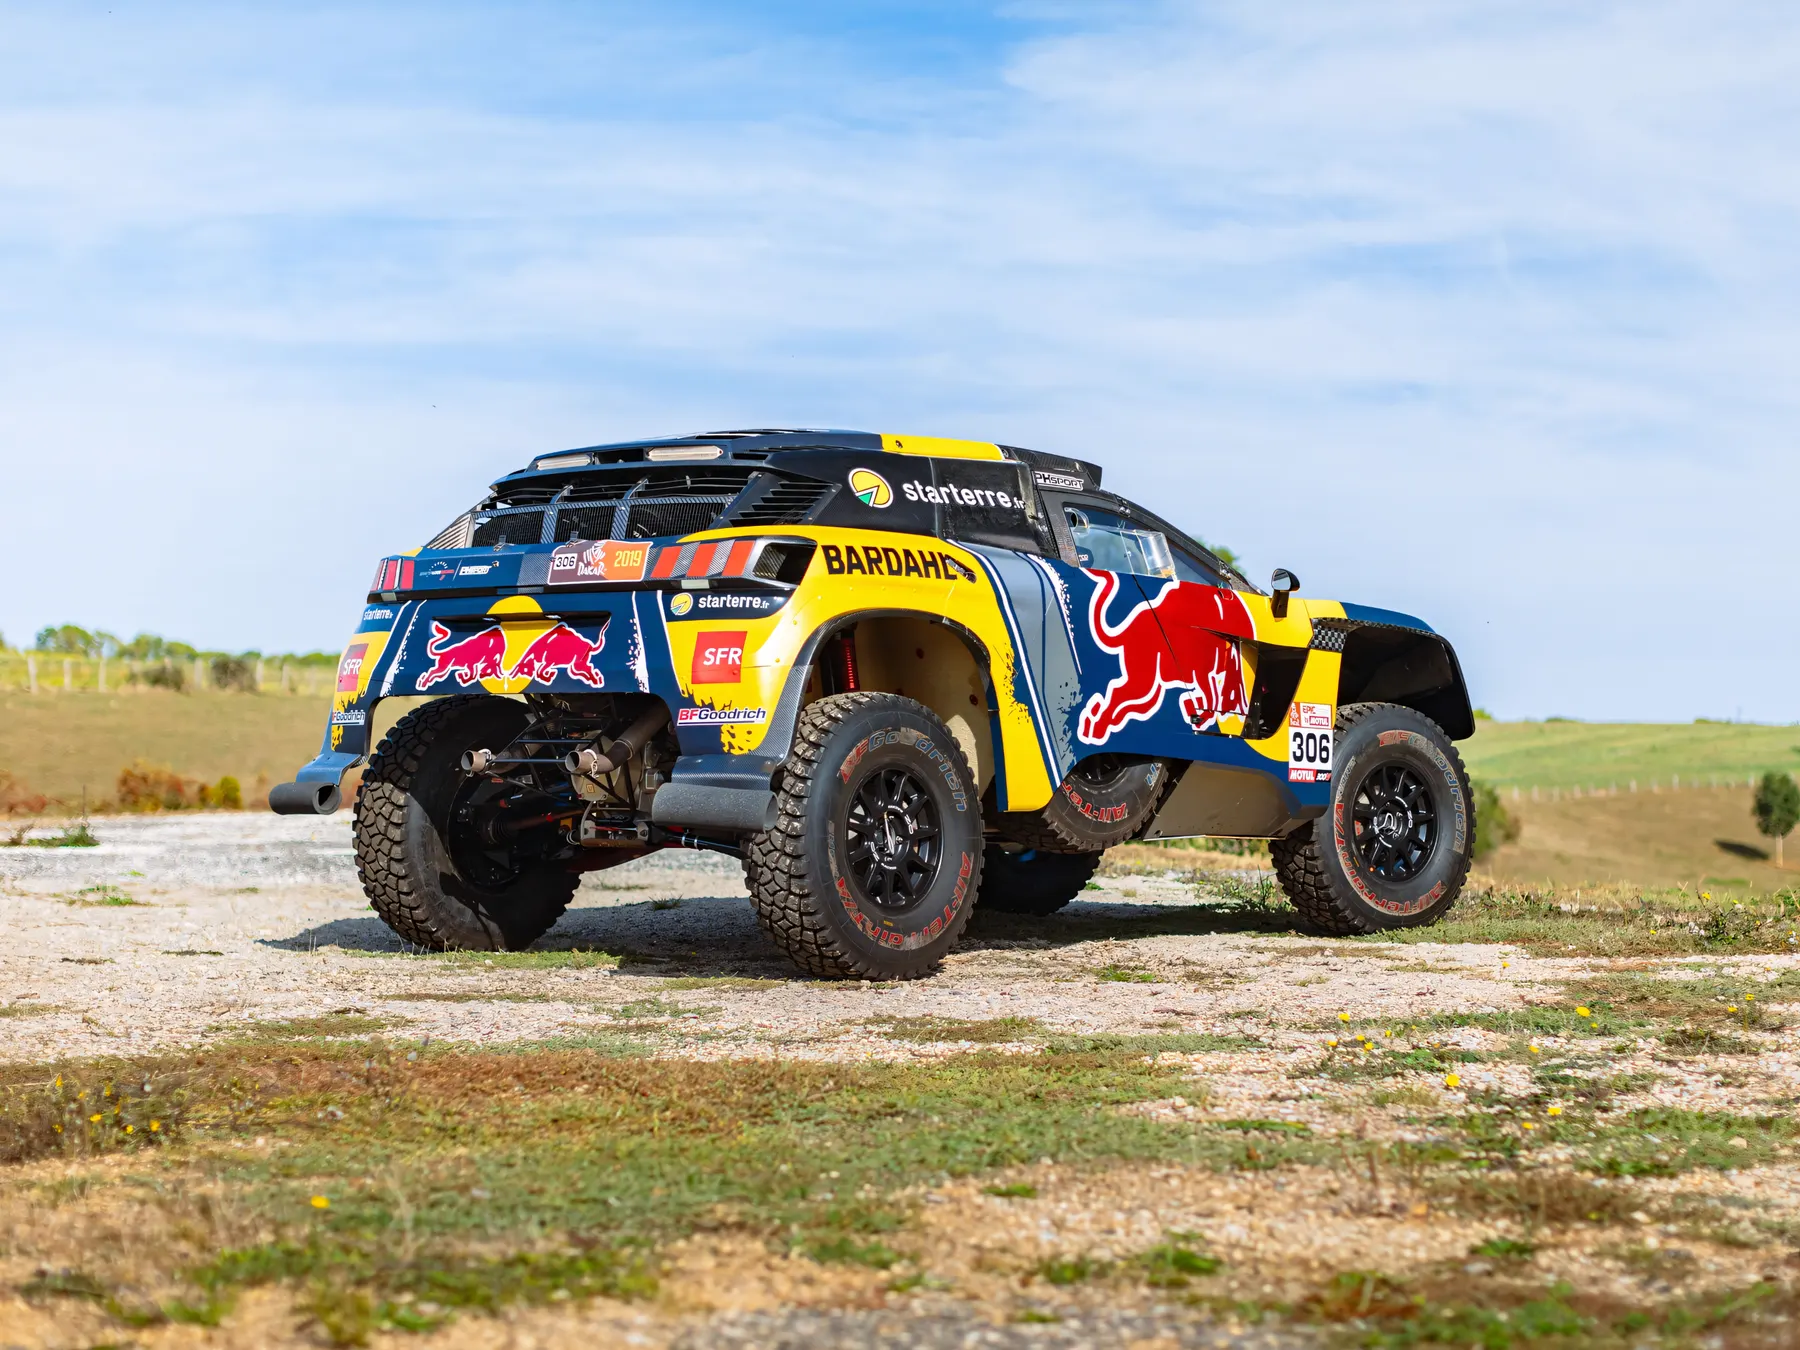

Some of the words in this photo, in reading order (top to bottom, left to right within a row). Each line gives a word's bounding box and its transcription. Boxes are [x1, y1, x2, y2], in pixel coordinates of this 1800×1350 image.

[902, 480, 1026, 510] starterre.fr
[556, 556, 576, 568] 306
[614, 550, 642, 567] 2019
[821, 544, 958, 581] BARDAHL
[577, 562, 606, 576] DAKAR
[697, 594, 769, 609] starterre.fr
[703, 647, 743, 666] SFR
[343, 658, 363, 675] SFR
[332, 709, 366, 722] FGoodrich
[679, 707, 767, 721] BFGoodrich
[1292, 731, 1330, 764] 306
[839, 727, 968, 812] FGodrich
[1290, 769, 1315, 781] MOTUL
